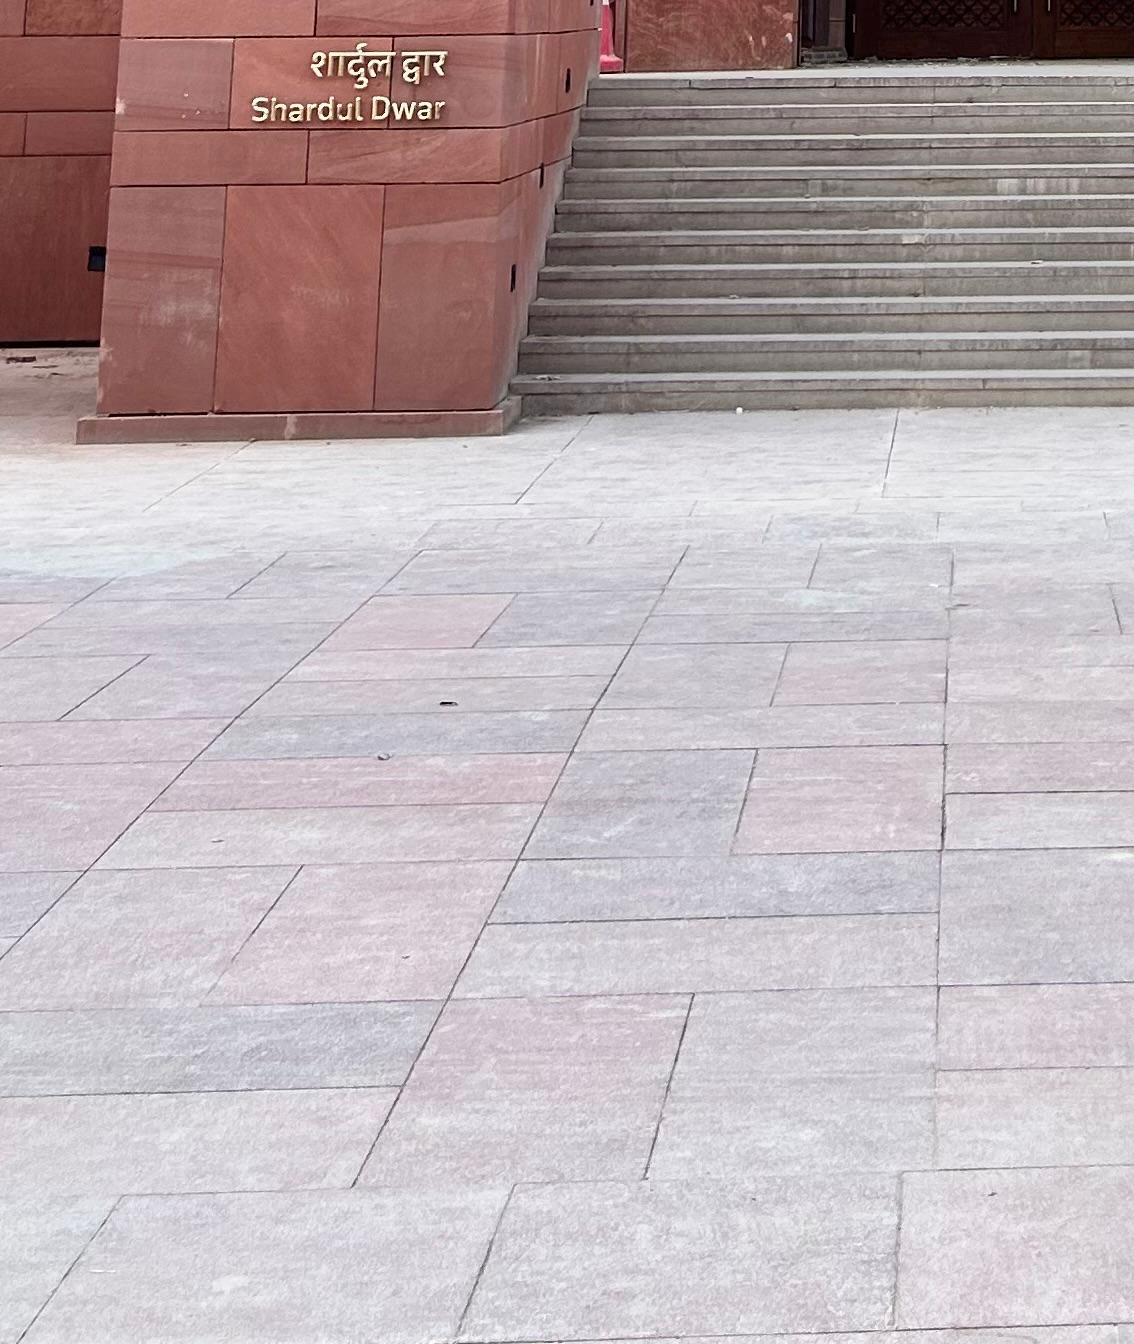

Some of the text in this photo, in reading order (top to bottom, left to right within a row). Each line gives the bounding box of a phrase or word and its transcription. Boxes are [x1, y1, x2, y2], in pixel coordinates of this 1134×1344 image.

[310, 42, 448, 89] शार्दुल द्वार
[251, 96, 446, 122] Shardul Dwar
